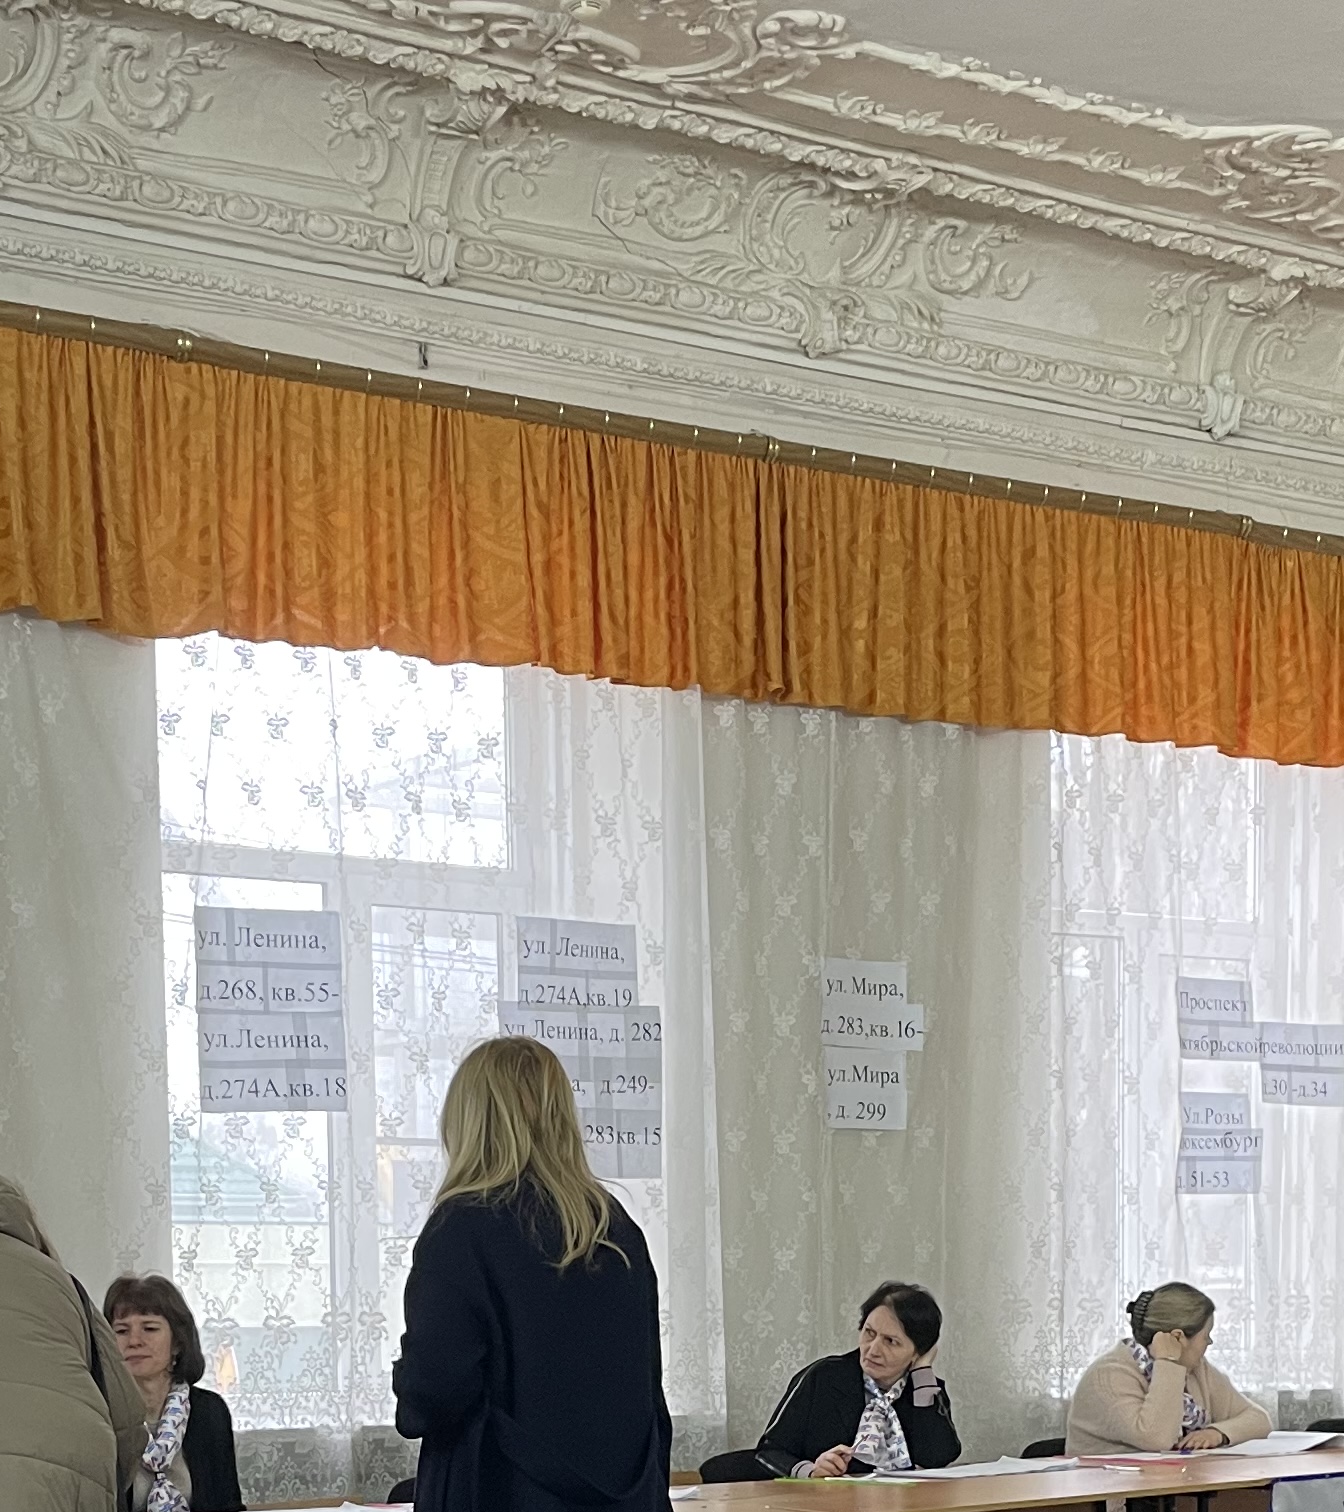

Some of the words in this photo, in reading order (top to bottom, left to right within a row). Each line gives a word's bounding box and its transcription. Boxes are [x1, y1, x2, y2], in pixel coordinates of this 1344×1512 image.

[198, 929, 226, 951] ул.
[234, 926, 327, 953] Ленина,
[523, 939, 550, 959] ул.
[555, 936, 625, 964] Ленина,
[199, 979, 264, 1005] д.268,
[826, 978, 847, 997] ул.
[852, 976, 904, 1001] Мира,
[1179, 991, 1248, 1015] Проспект
[533, 1019, 604, 1044] Ленина,
[609, 1027, 624, 1043] д.
[855, 1101, 887, 1122] 299
[1190, 1170, 1230, 1188] 51-53
